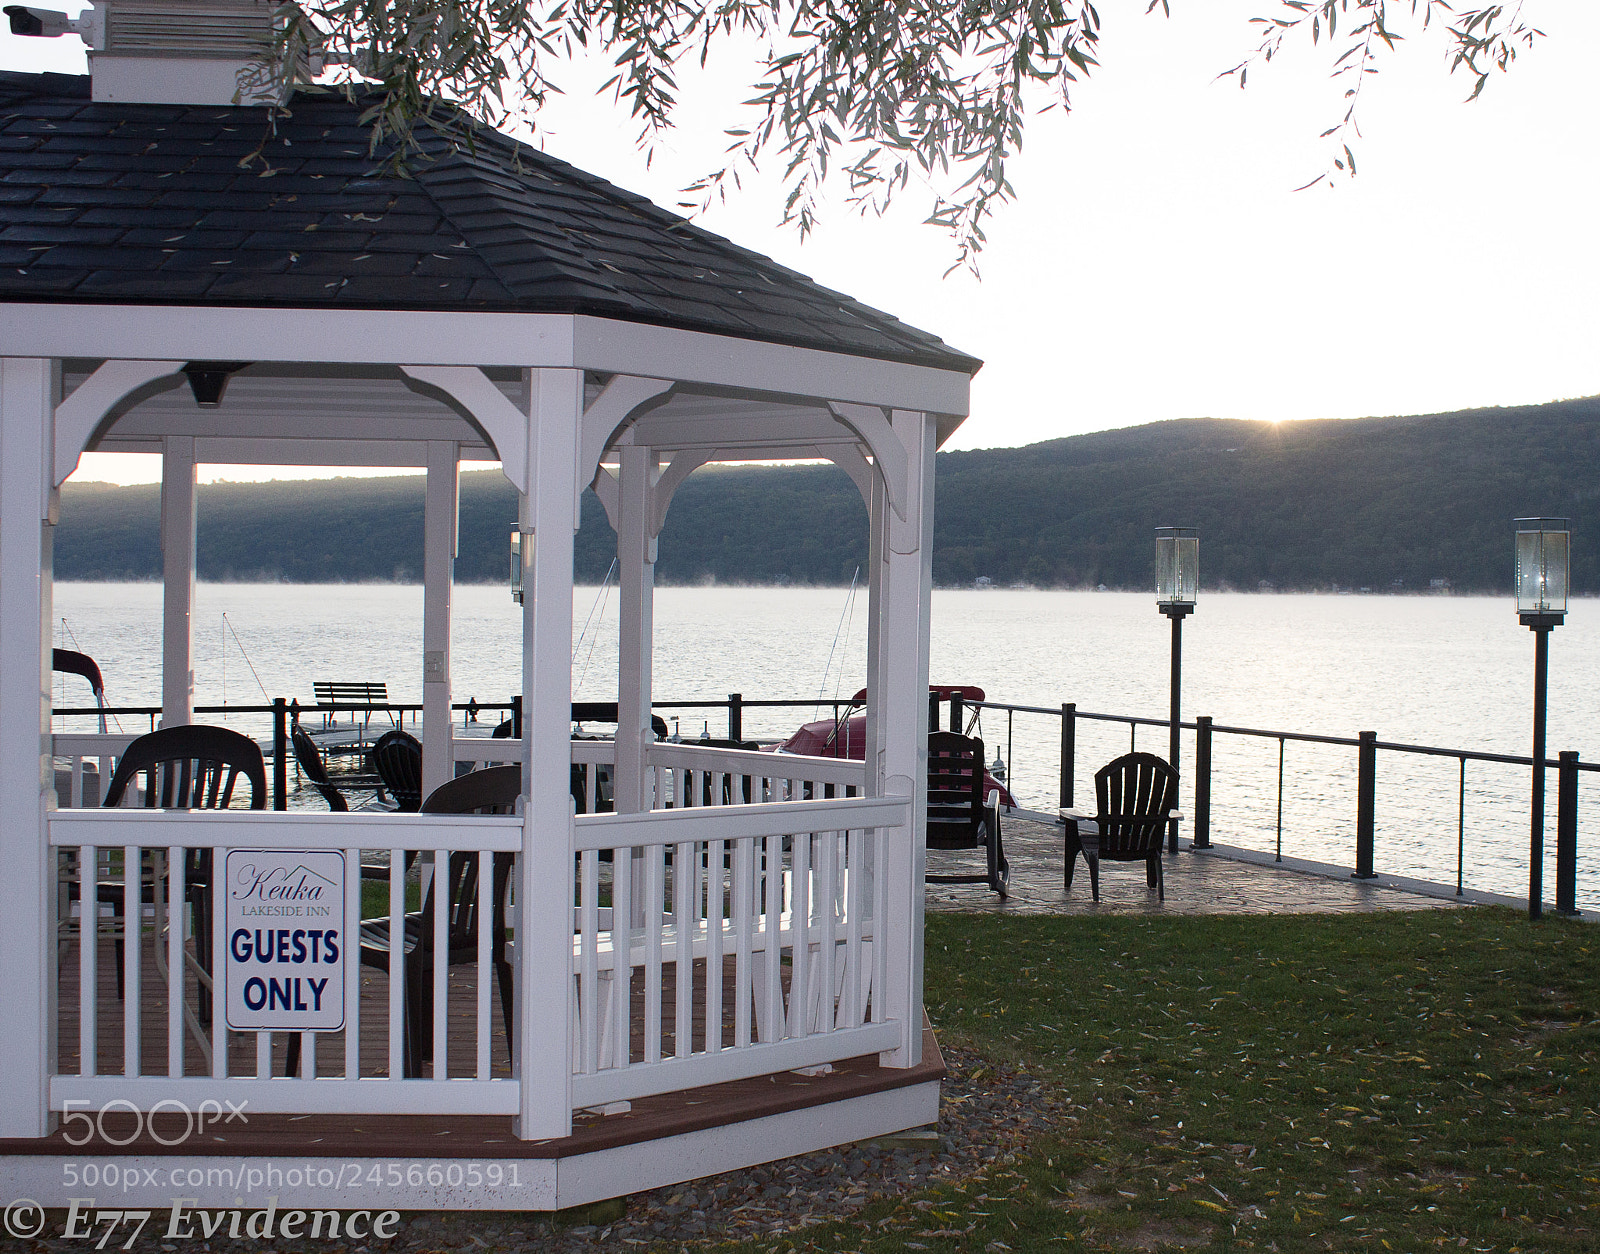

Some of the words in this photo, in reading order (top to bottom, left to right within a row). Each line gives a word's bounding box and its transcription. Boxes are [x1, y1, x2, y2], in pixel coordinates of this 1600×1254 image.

[232, 863, 325, 902] Keuka
[241, 905, 301, 917] LAKESIDE
[306, 906, 330, 917] INN
[230, 928, 340, 964] GUESTS
[243, 976, 329, 1012] ONLY
